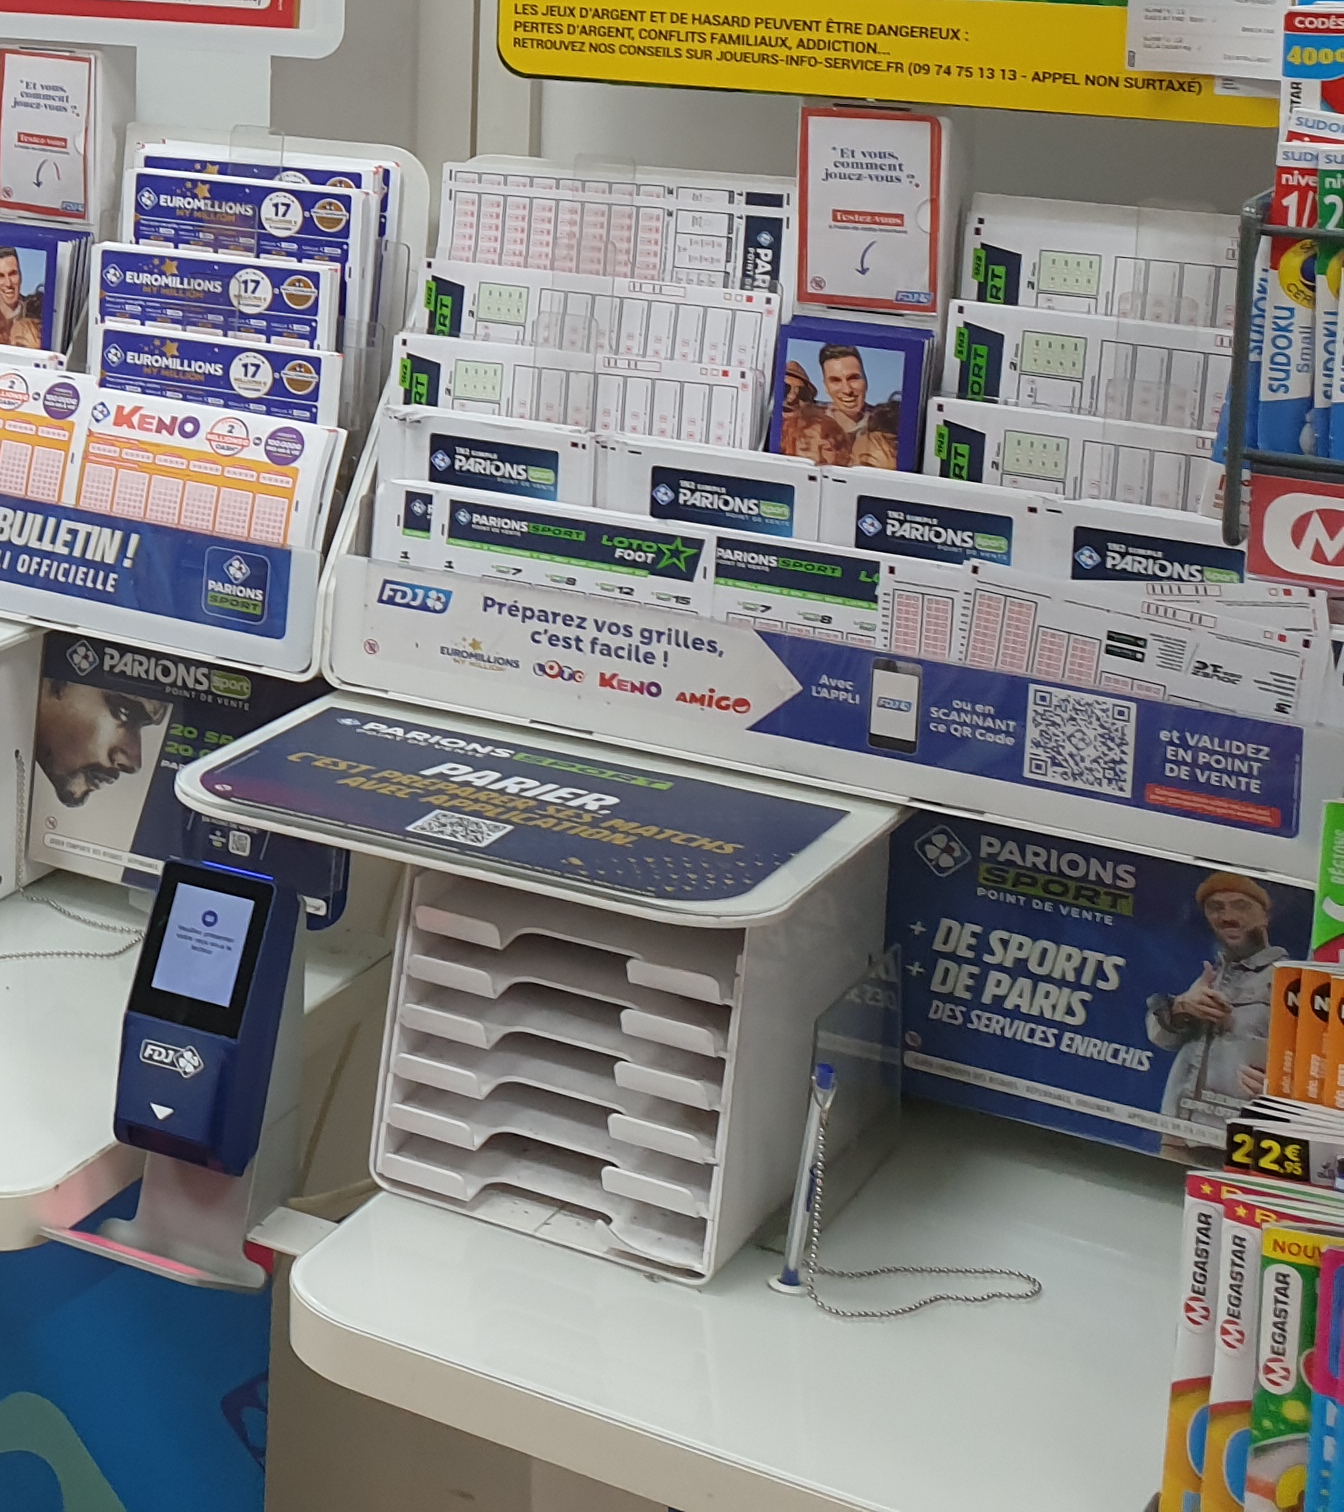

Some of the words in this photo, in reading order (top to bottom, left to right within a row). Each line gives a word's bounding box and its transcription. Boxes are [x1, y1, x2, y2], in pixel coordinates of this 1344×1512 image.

[514, 2, 539, 16] LES
[540, 3, 577, 19] JEUX
[579, 6, 647, 25] D'ARGENT
[649, 9, 667, 25] ET
[669, 11, 689, 26] DE
[691, 12, 752, 30] HASARD
[754, 16, 822, 34] PEUVENT
[826, 14, 864, 36] ÊTRE
[866, 22, 960, 42] DANGEREUX
[514, 20, 564, 37] PERTES
[566, 23, 636, 42] D'ARGENT,
[638, 26, 708, 45] CONFLITS
[710, 30, 793, 51] FAMILIAUX,
[513, 36, 586, 54] RETROUVEZ
[588, 41, 615, 56] NOS
[618, 42, 683, 60] CONSEILS
[685, 46, 713, 62] SUR
[715, 48, 905, 75] JOUEURS-INFO-SERVICE.FR
[907, 60, 931, 78] (09
[934, 62, 953, 78] 74
[956, 64, 974, 79] 75
[1031, 70, 1081, 87] APPEL
[1084, 72, 1120, 89] NON
[833, 159, 905, 172] comment
[158, 194, 254, 217] EUROMILLIONS
[271, 202, 291, 218] 17
[125, 271, 223, 293] EUROMILLIONS
[241, 278, 260, 295] 17
[126, 351, 223, 377] EUROMILLIONS
[1268, 304, 1295, 394] SUDOKU
[113, 404, 201, 440] KENO
[454, 454, 528, 481] PARIONS
[678, 488, 760, 515] PARIONS
[472, 513, 529, 533] PARIONS
[529, 523, 586, 541] SPORT
[885, 520, 974, 549] PARIONS
[601, 535, 658, 552] LOTO
[614, 548, 657, 564] FOOT
[16, 550, 119, 594] OFFICIELLE
[1106, 553, 1203, 583] PARIONS
[481, 596, 588, 633] Préparez
[594, 616, 634, 638] vos
[639, 621, 725, 658] grilles,
[530, 626, 584, 653] c'est
[589, 637, 656, 665] facile
[103, 647, 210, 692] PARIONS
[598, 671, 662, 698] KENO
[818, 674, 855, 690] Avec
[216, 695, 251, 711] VENTE
[811, 685, 860, 705] L'APPLI
[929, 706, 1017, 733] SCANNANT
[360, 721, 516, 760] PARIONS
[949, 724, 972, 738] QR
[975, 729, 1016, 747] Code
[1184, 730, 1271, 760] VALIDEZ
[1165, 745, 1194, 763] EN
[1197, 750, 1262, 777] POINT
[419, 761, 621, 816] PARIER,
[1163, 762, 1190, 780] DE
[1193, 765, 1262, 794] VENTE
[979, 834, 1137, 889] PARIONS
[977, 887, 1027, 908] POINT
[1031, 899, 1055, 912] DE
[1059, 903, 1115, 926] VENTE
[932, 916, 985, 958] DE
[983, 929, 1127, 992] SPORTS
[930, 958, 981, 1001] DE
[981, 970, 1093, 1028] PARIS
[927, 999, 966, 1027] DES
[967, 1009, 1059, 1049] SERVICES
[1059, 1032, 1155, 1073] ENRICHIS
[144, 1044, 175, 1064] FDJ
[1183, 1210, 1213, 1327] MEGASTAR
[1220, 1234, 1248, 1351] MEGASTAR
[1261, 1271, 1292, 1389] MEGASTAR
